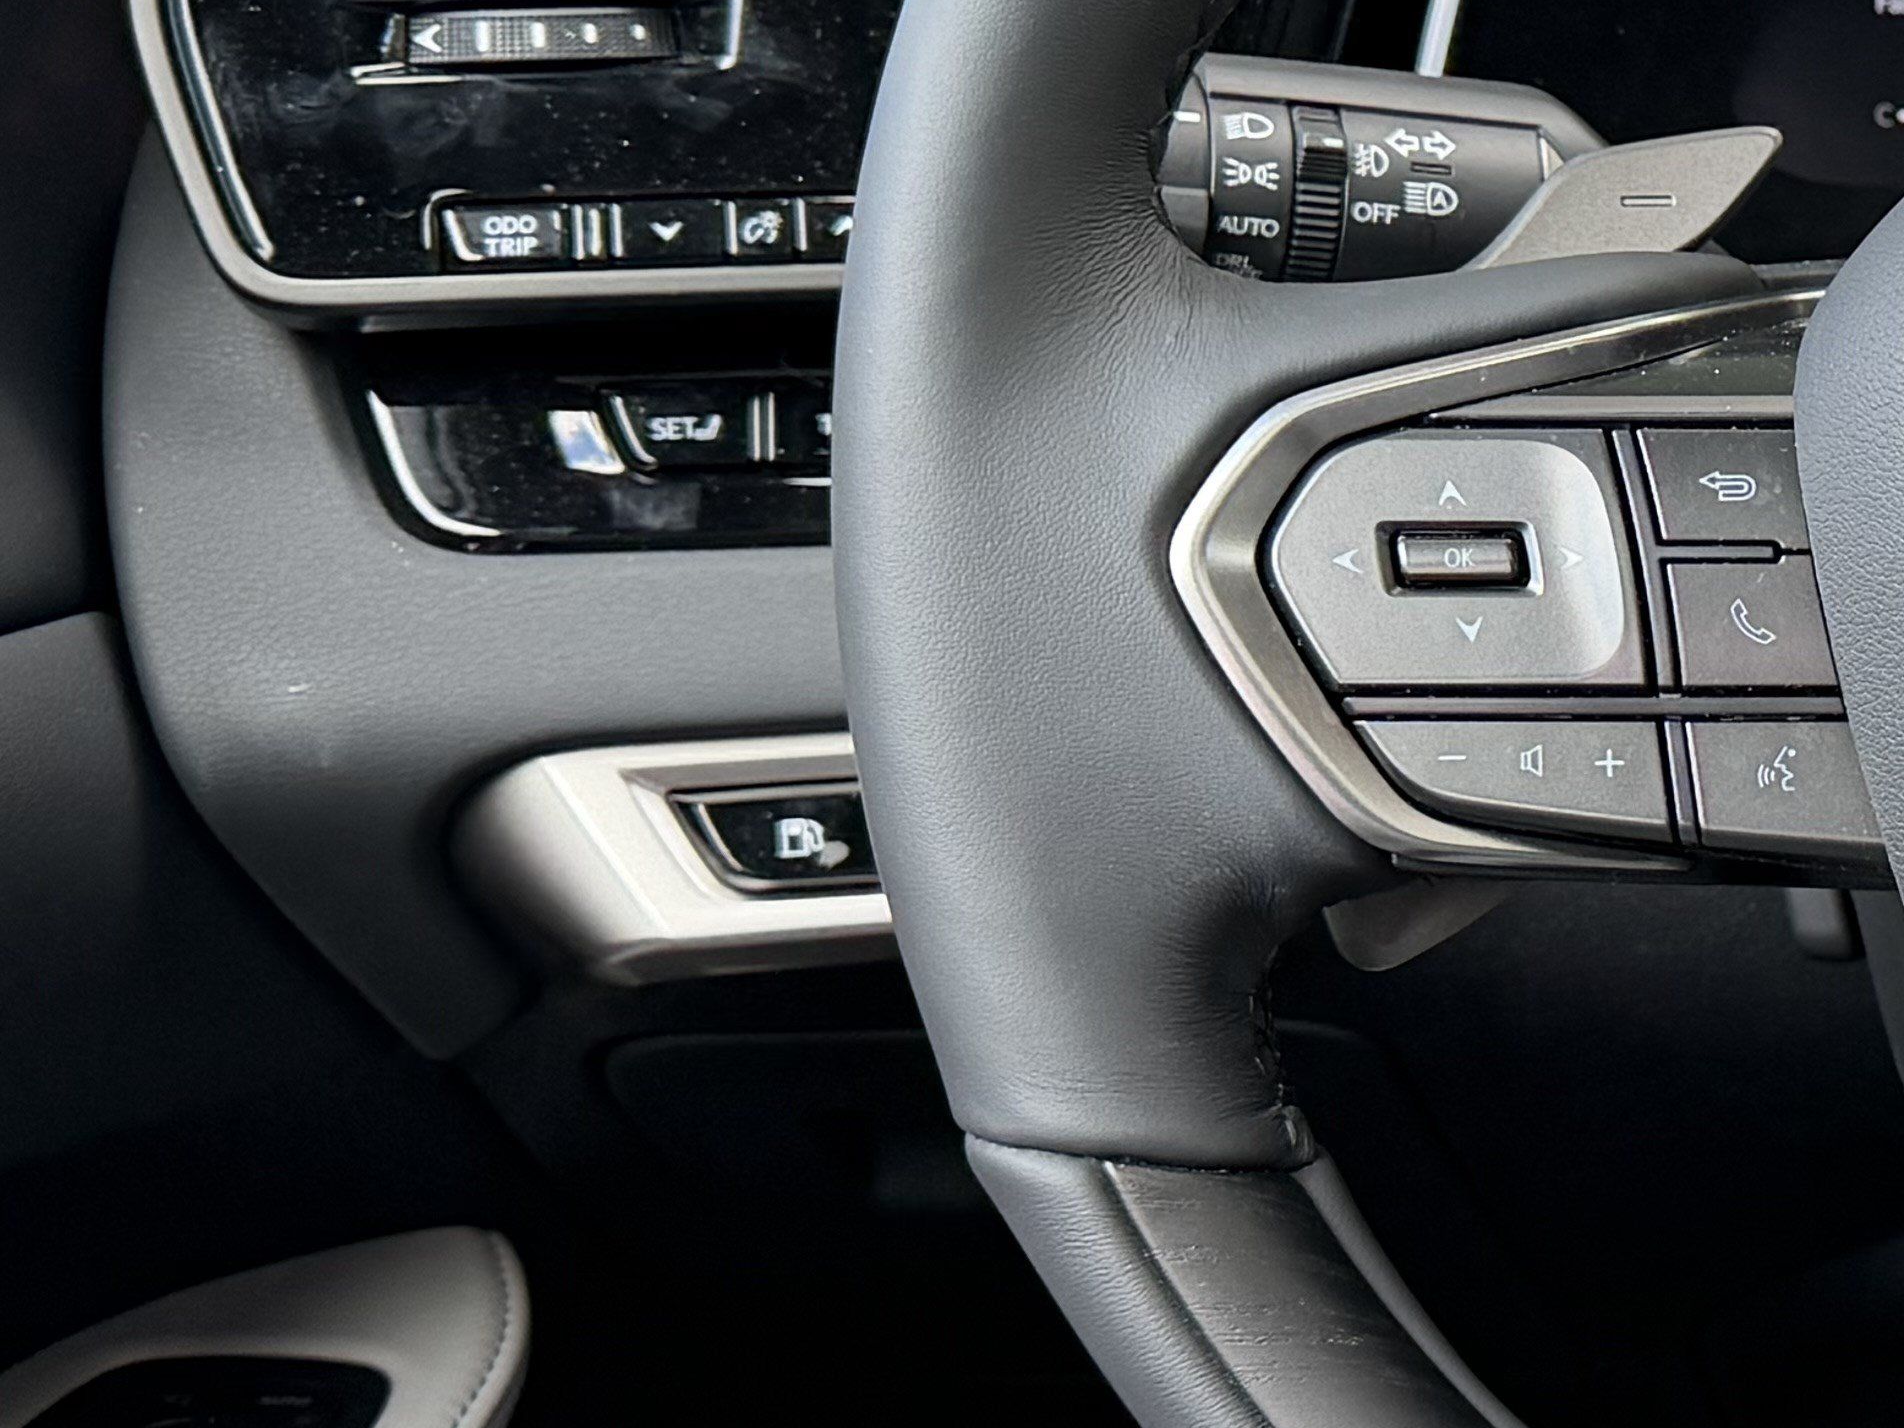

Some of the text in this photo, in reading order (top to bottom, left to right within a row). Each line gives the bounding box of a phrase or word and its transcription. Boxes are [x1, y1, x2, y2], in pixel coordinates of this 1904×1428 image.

[1351, 201, 1401, 225] OFF
[484, 215, 538, 235] ODO
[1217, 215, 1280, 239] AUTO
[484, 236, 539, 257] TRIP
[648, 416, 699, 441] SET
[1444, 546, 1476, 568] OK
